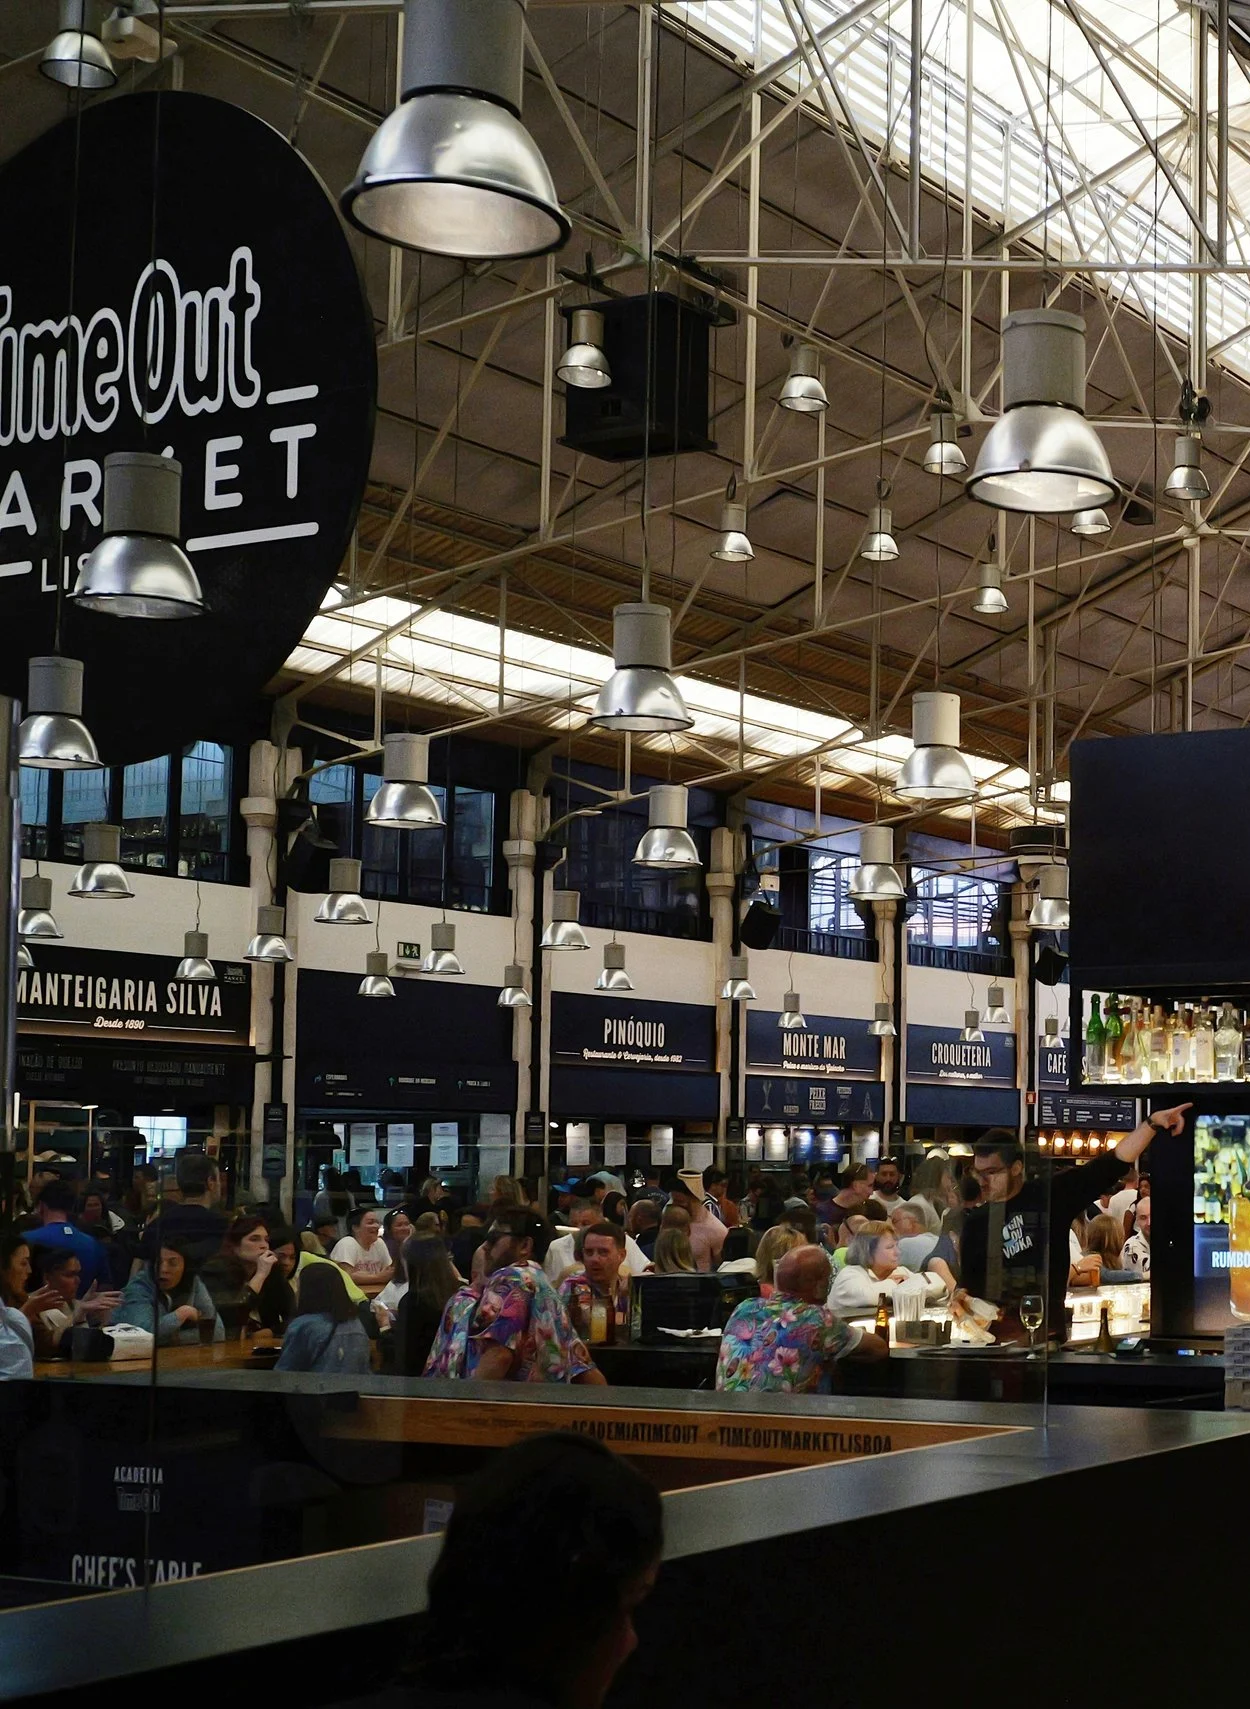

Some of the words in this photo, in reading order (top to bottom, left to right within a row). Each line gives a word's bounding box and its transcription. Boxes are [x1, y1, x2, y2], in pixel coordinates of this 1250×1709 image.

[128, 246, 261, 425] Out
[0, 423, 317, 536] ARET
[16, 970, 158, 1013] MANTEIGARIA
[166, 982, 222, 1017] SILVA
[93, 1016, 124, 1029] Desde
[124, 1019, 145, 1030] 1890
[604, 1016, 665, 1048] PINÓQUIO
[783, 1032, 819, 1058] MONTE
[823, 1035, 846, 1060] MAR
[931, 1042, 992, 1068] CROQUETERIA
[1047, 1050, 1067, 1074] CAFÉ
[1008, 1214, 1025, 1231] GIN
